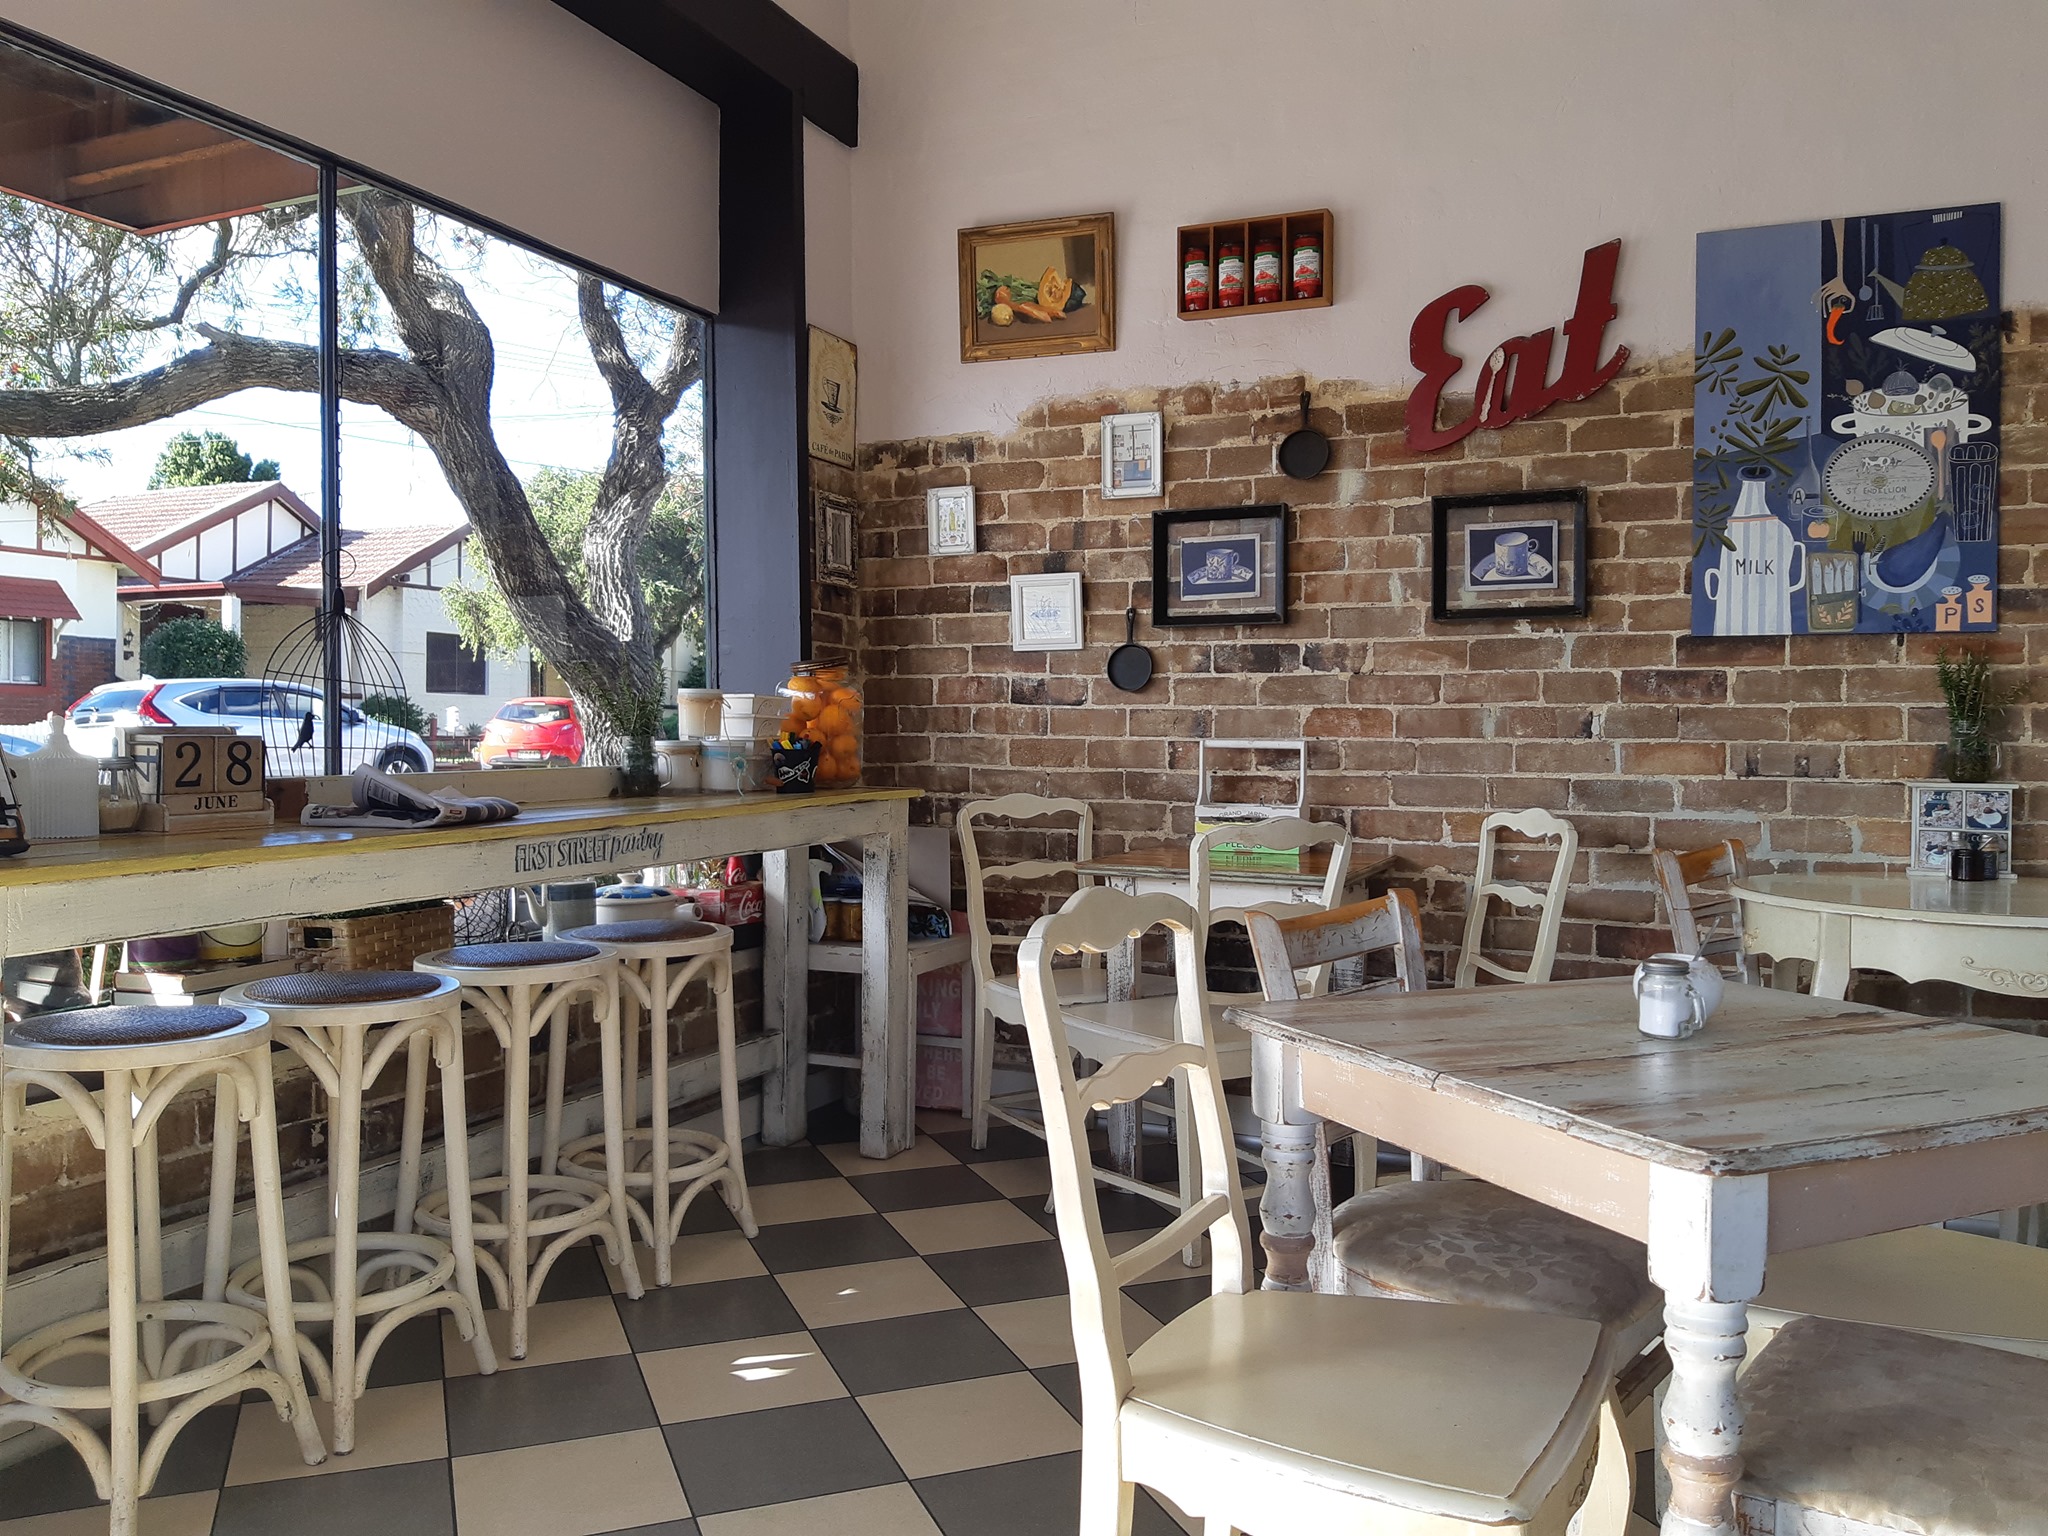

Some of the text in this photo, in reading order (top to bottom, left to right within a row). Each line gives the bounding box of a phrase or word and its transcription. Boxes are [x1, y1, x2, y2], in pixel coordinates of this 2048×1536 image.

[1405, 238, 1631, 451] Eat
[834, 449, 852, 461] PARIS
[1794, 490, 1803, 505] A
[1846, 487, 1857, 495] ST
[1736, 558, 1774, 576] MILK
[1973, 598, 1984, 613] S
[1945, 607, 1957, 624] P
[194, 795, 238, 810] JUNE
[1219, 810, 1242, 818] GRAND
[515, 827, 664, 872] FIRST STREET pantry
